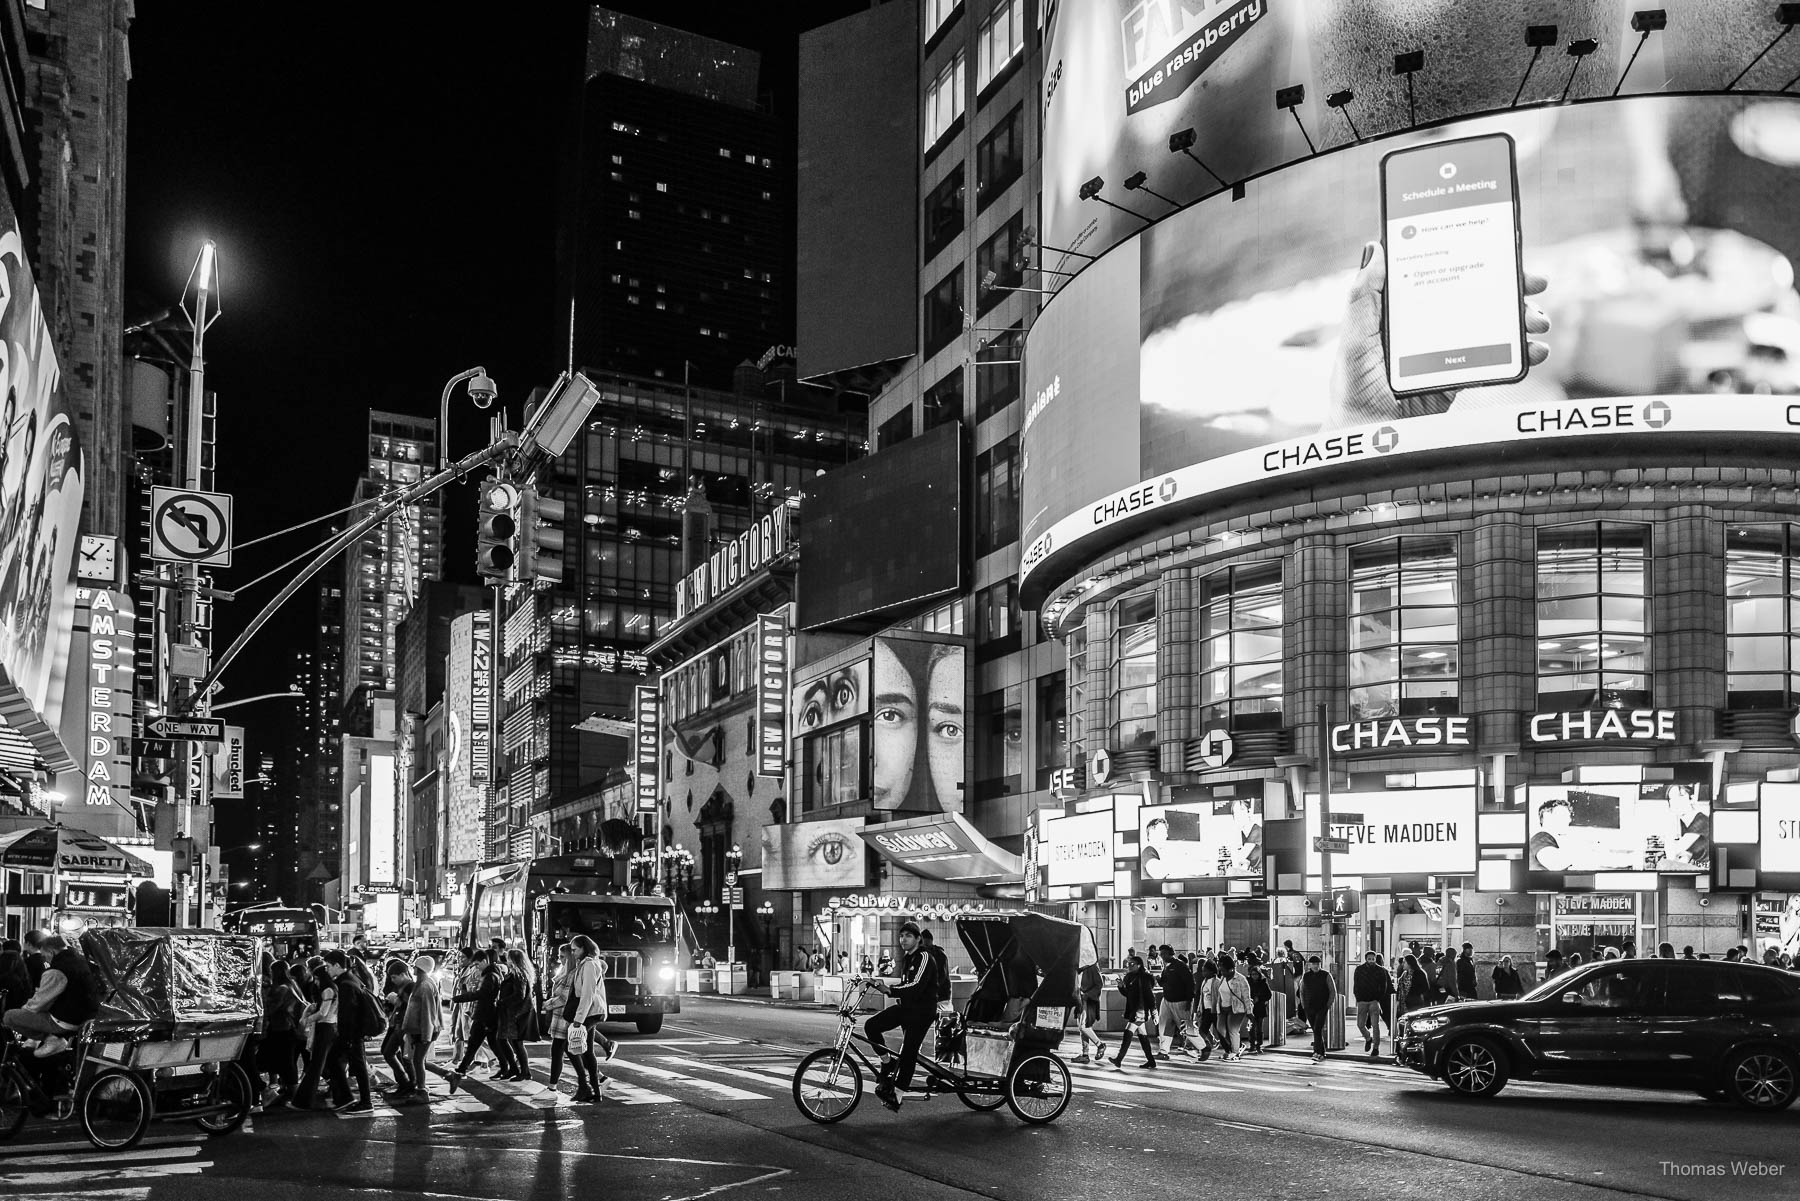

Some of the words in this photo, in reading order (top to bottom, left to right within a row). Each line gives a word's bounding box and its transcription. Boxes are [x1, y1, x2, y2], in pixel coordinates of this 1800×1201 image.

[1129, 71, 1163, 107] blue
[1166, 0, 1262, 78] raspberry
[1402, 186, 1446, 202] Schedule
[1448, 186, 1454, 194] a
[1456, 179, 1497, 193] Meeting
[1414, 269, 1437, 279] Open
[1449, 261, 1485, 273] upgrade
[1444, 356, 1467, 365] Next
[1517, 404, 1634, 433] CHASE
[1263, 433, 1364, 472] CHASE
[1093, 485, 1155, 525] CHASE
[676, 563, 709, 620] NEW
[711, 504, 788, 598] VICTORY
[76, 588, 91, 600] EW
[763, 620, 784, 714] VICTORY
[88, 590, 116, 806] AMSTERDAM
[156, 722, 178, 733] ONE
[190, 724, 215, 735] WAY
[640, 690, 657, 764] VICTORY
[1332, 716, 1470, 751] CHASE
[1530, 710, 1676, 742] CHASE
[142, 741, 149, 755] 7
[153, 742, 163, 751] Av
[473, 746, 489, 776] DUKE
[763, 730, 783, 772] NEW
[230, 737, 242, 792] shucked
[639, 773, 656, 809] NEW
[875, 830, 958, 853] Subway
[1384, 822, 1457, 844] MADDEN
[61, 855, 124, 867] SABRETT
[848, 893, 908, 910] Subway
[1558, 897, 1588, 910] STEVE
[1590, 897, 1632, 910] MADDEN
